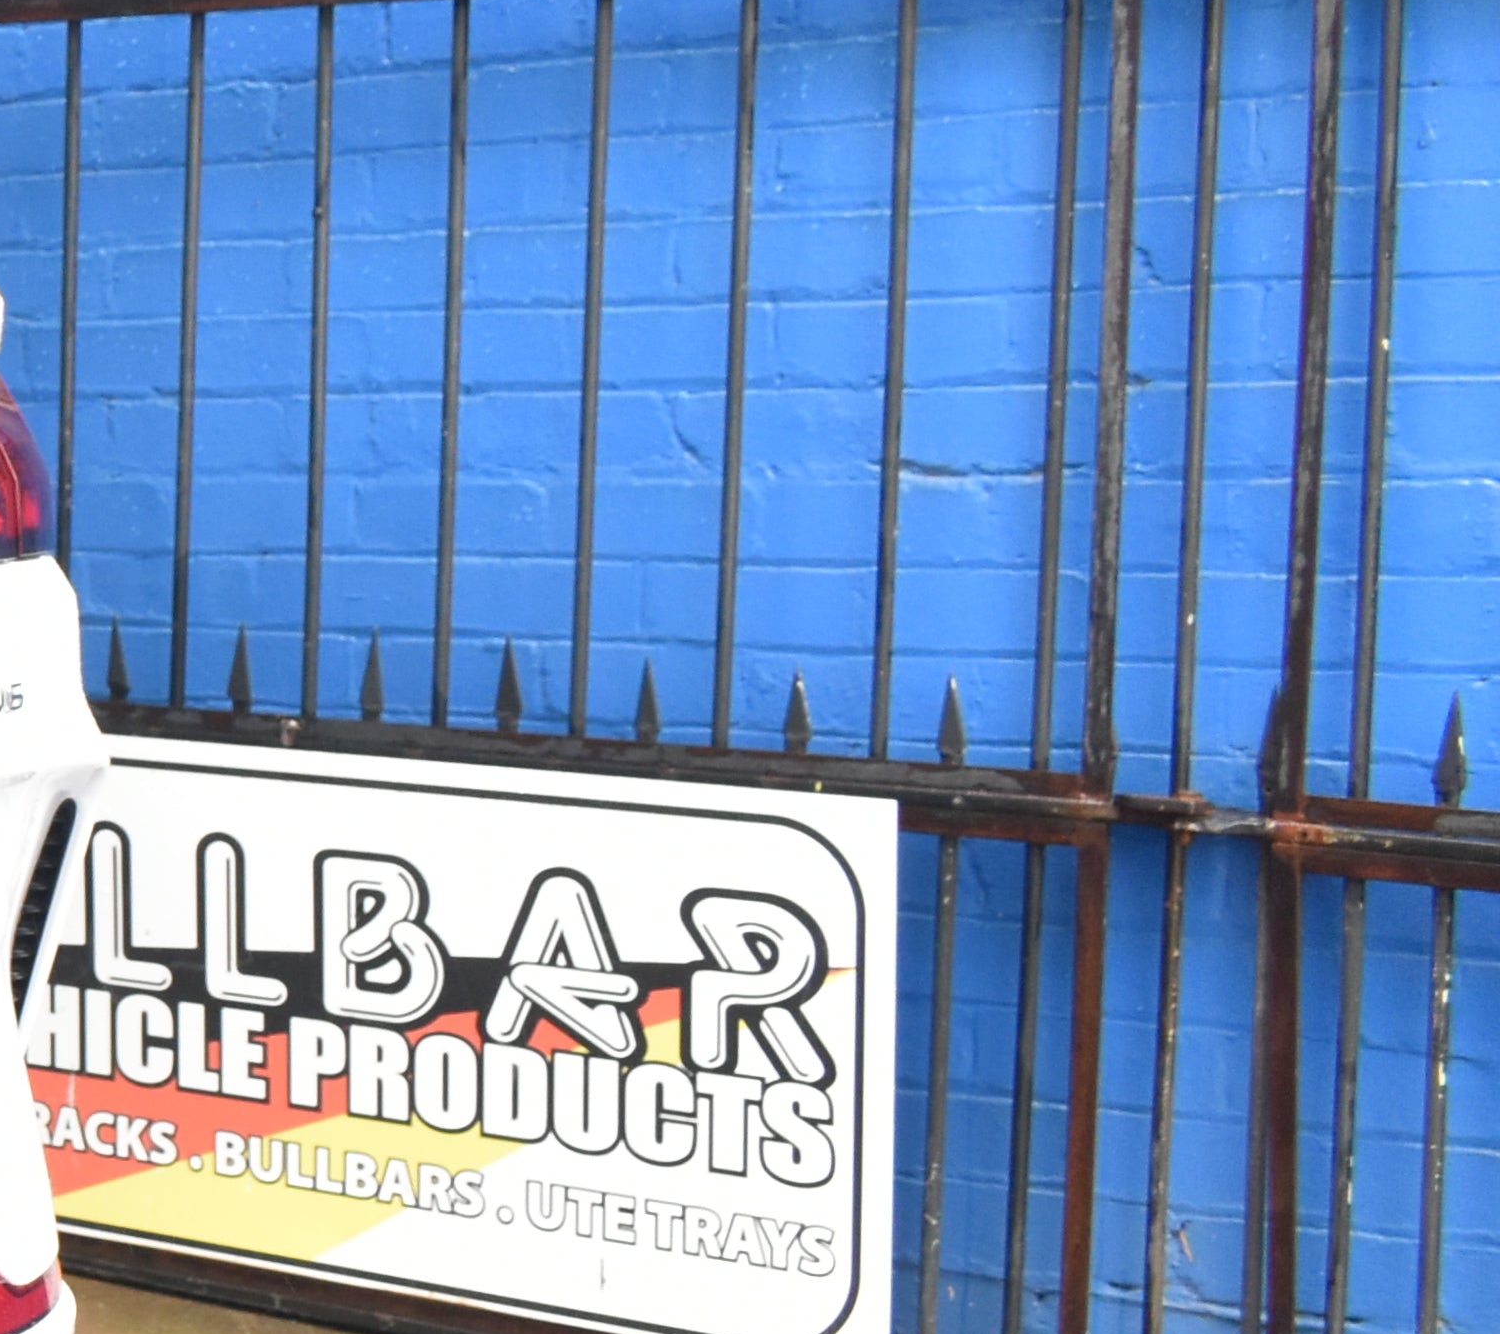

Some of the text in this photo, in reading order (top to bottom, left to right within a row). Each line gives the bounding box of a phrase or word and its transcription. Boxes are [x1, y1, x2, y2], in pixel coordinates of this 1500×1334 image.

[288, 1019, 836, 1188] PRODUCTS
[214, 1130, 486, 1219] BULLBARS
[525, 1179, 638, 1245] UTE
[643, 1197, 837, 1277] TRAYS
